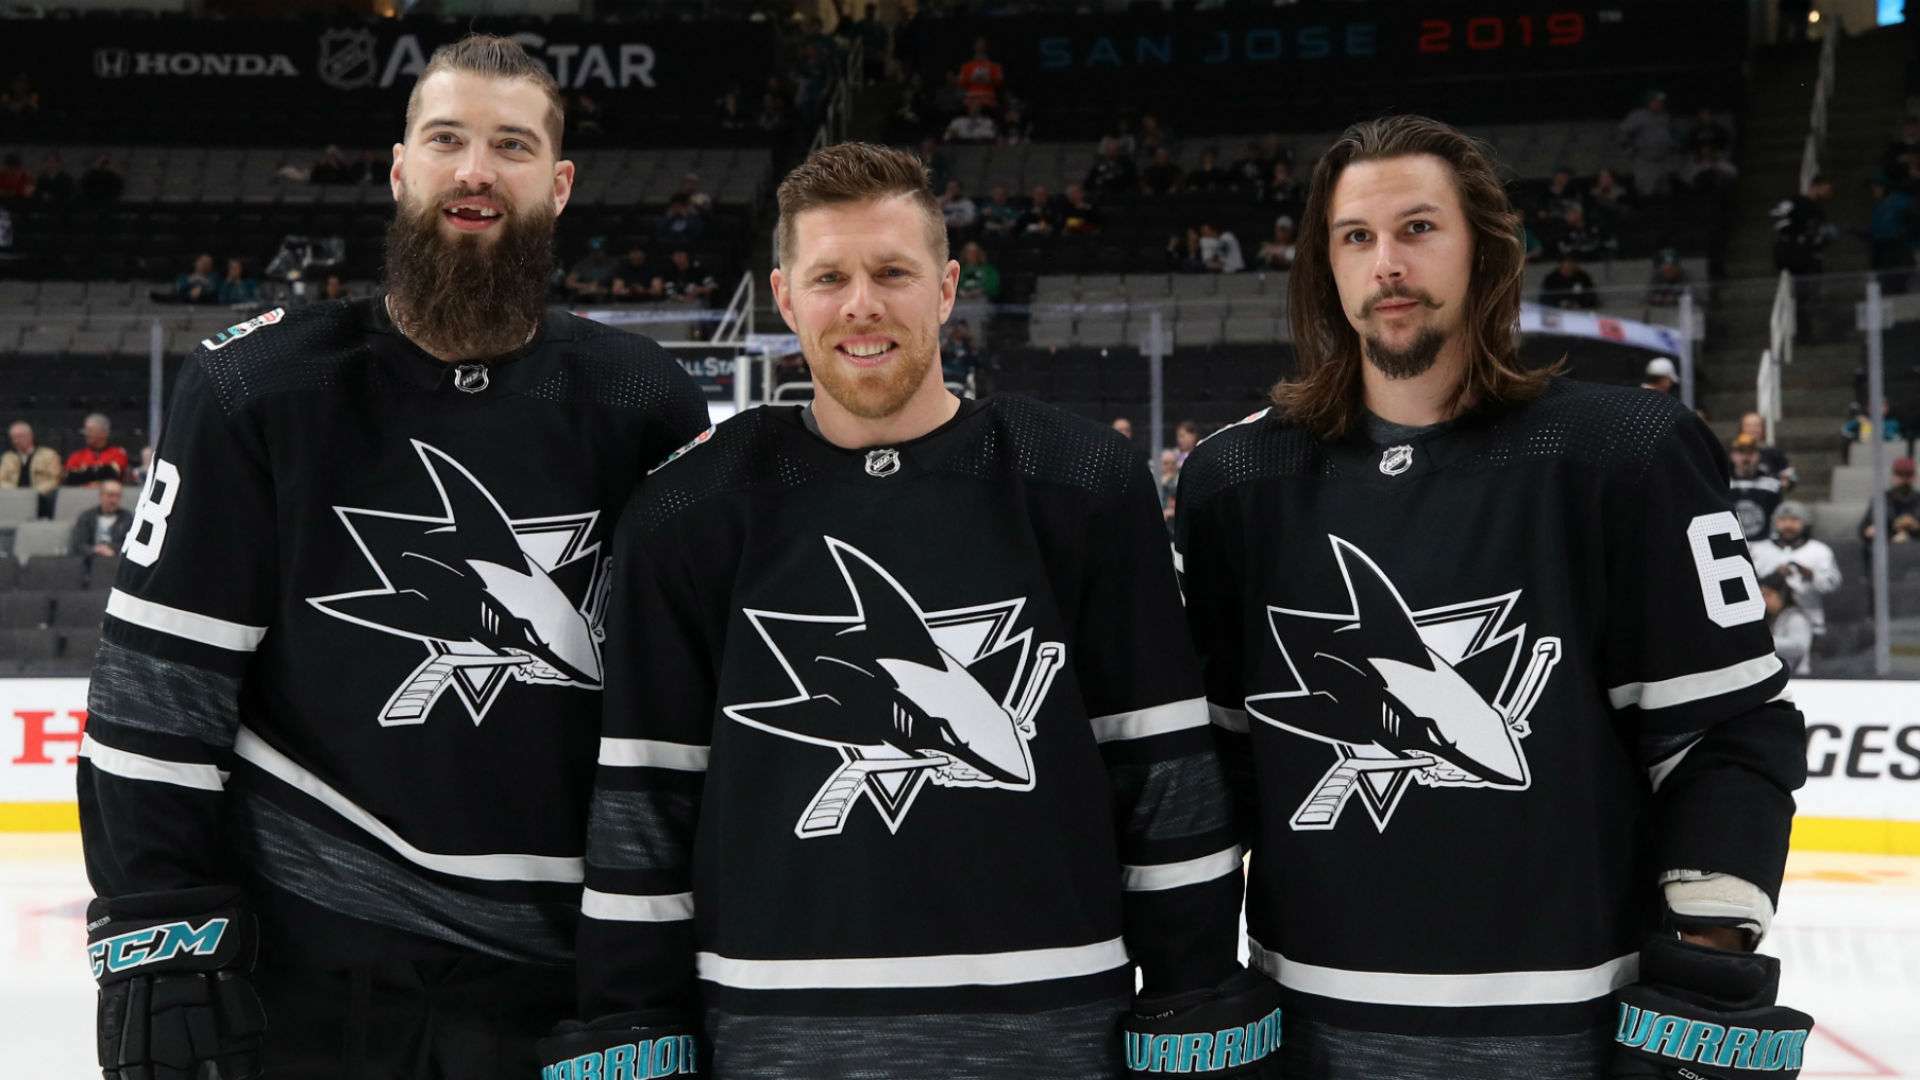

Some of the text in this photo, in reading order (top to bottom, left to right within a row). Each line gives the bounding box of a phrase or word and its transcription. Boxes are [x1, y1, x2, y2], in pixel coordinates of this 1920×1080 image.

[136, 52, 299, 76] HONDA
[1039, 35, 1173, 71] SAN
[1203, 25, 1377, 64] JOSE
[1418, 12, 1585, 53] 2019
[1686, 510, 1767, 628] 6
[87, 918, 229, 978] CCM
[1125, 1007, 1282, 1073] WARRIOR
[1614, 1001, 1808, 1071] WARRIOR
